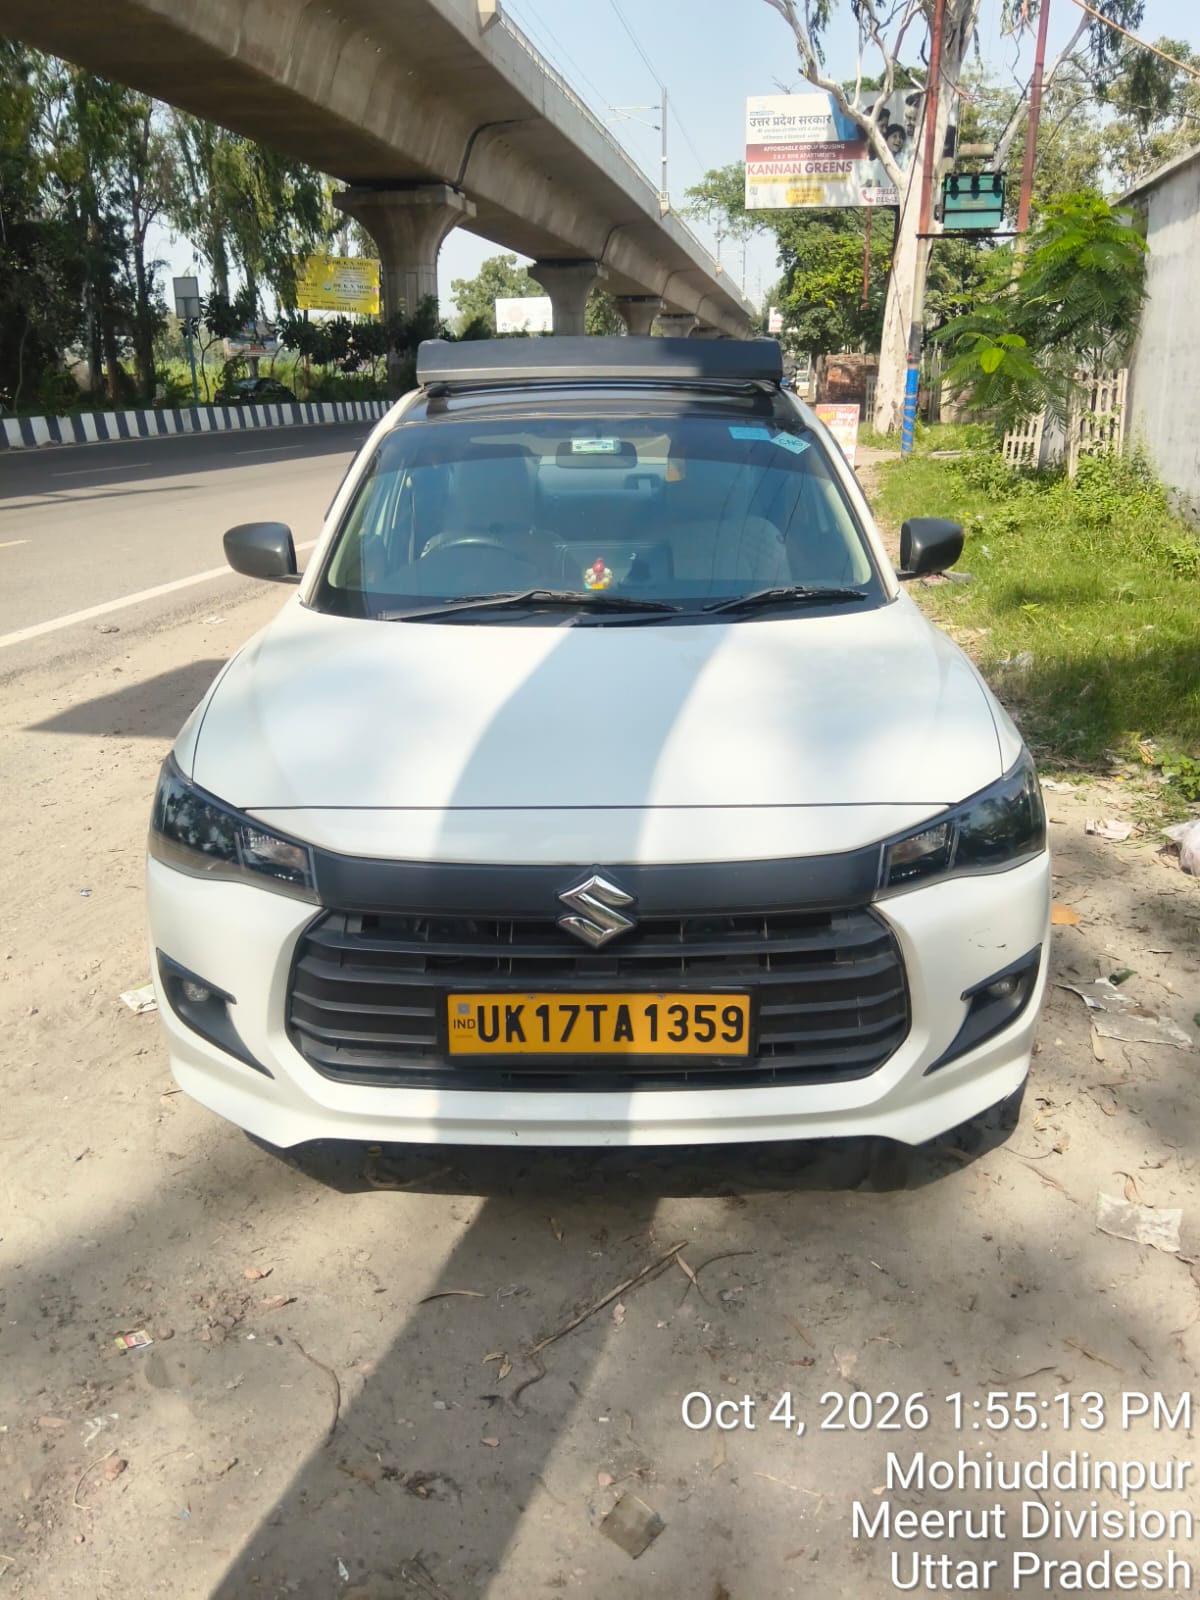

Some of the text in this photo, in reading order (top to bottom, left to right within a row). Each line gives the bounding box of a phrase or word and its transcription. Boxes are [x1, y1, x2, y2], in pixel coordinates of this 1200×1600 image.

[750, 117, 769, 127] उत्तर
[799, 115, 831, 126] सरकार
[747, 161, 853, 175] KANNAN GREENS
[453, 1019, 476, 1029] IND
[477, 1003, 744, 1043] UK17TA1359
